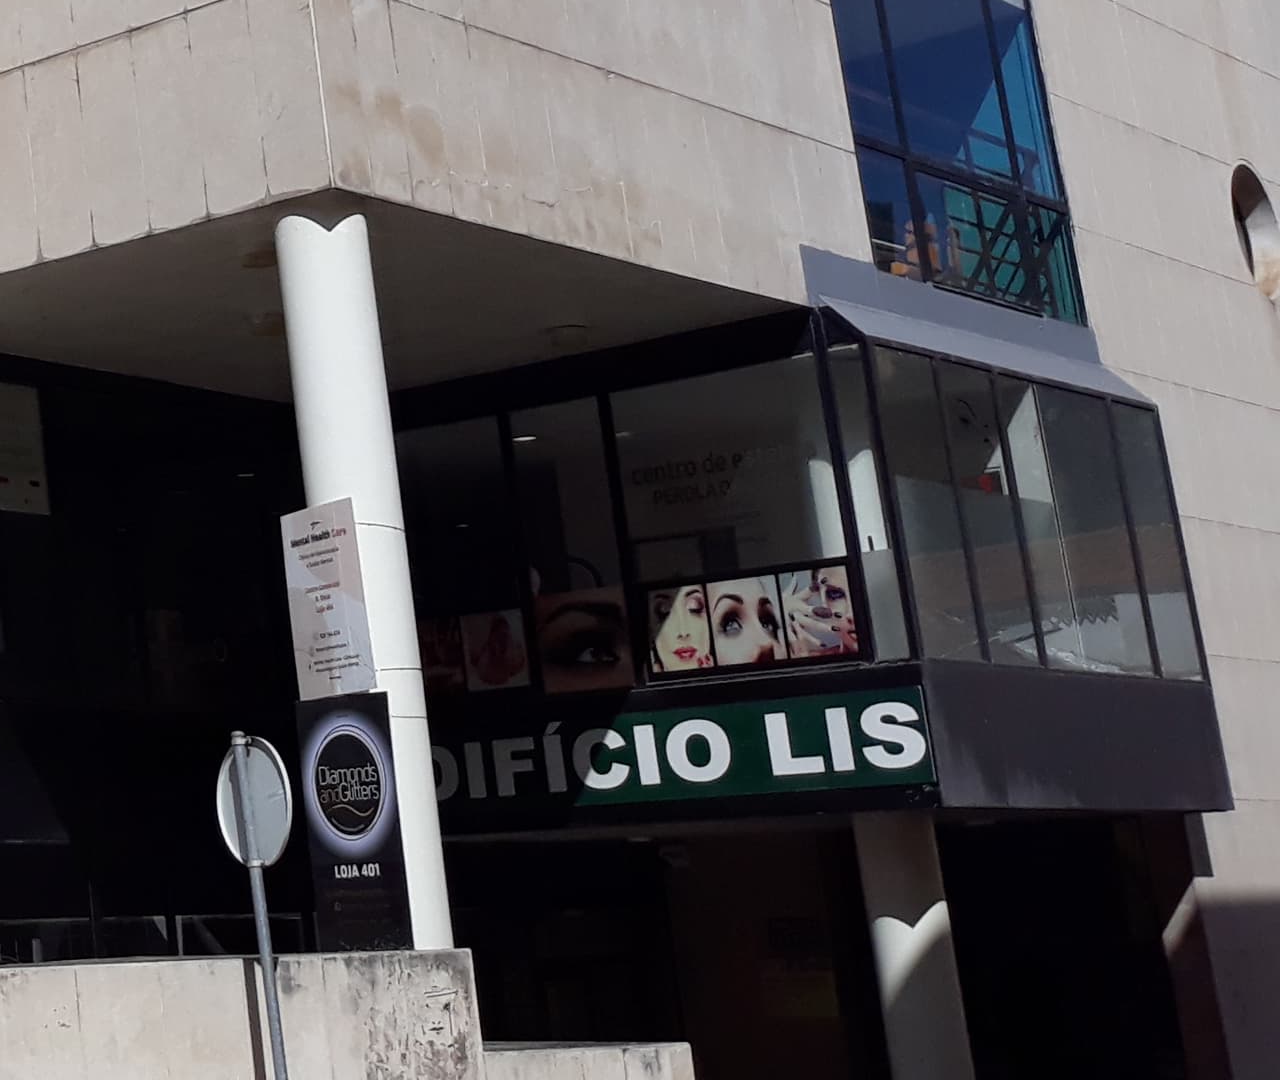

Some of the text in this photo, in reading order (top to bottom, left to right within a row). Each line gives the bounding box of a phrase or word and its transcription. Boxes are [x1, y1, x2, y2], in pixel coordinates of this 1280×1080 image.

[702, 450, 728, 473] de
[311, 529, 331, 544] Health
[432, 701, 927, 801] DIFÍCIO LIS
[318, 763, 378, 787] Diamonds
[334, 863, 381, 879] LOJA 401
